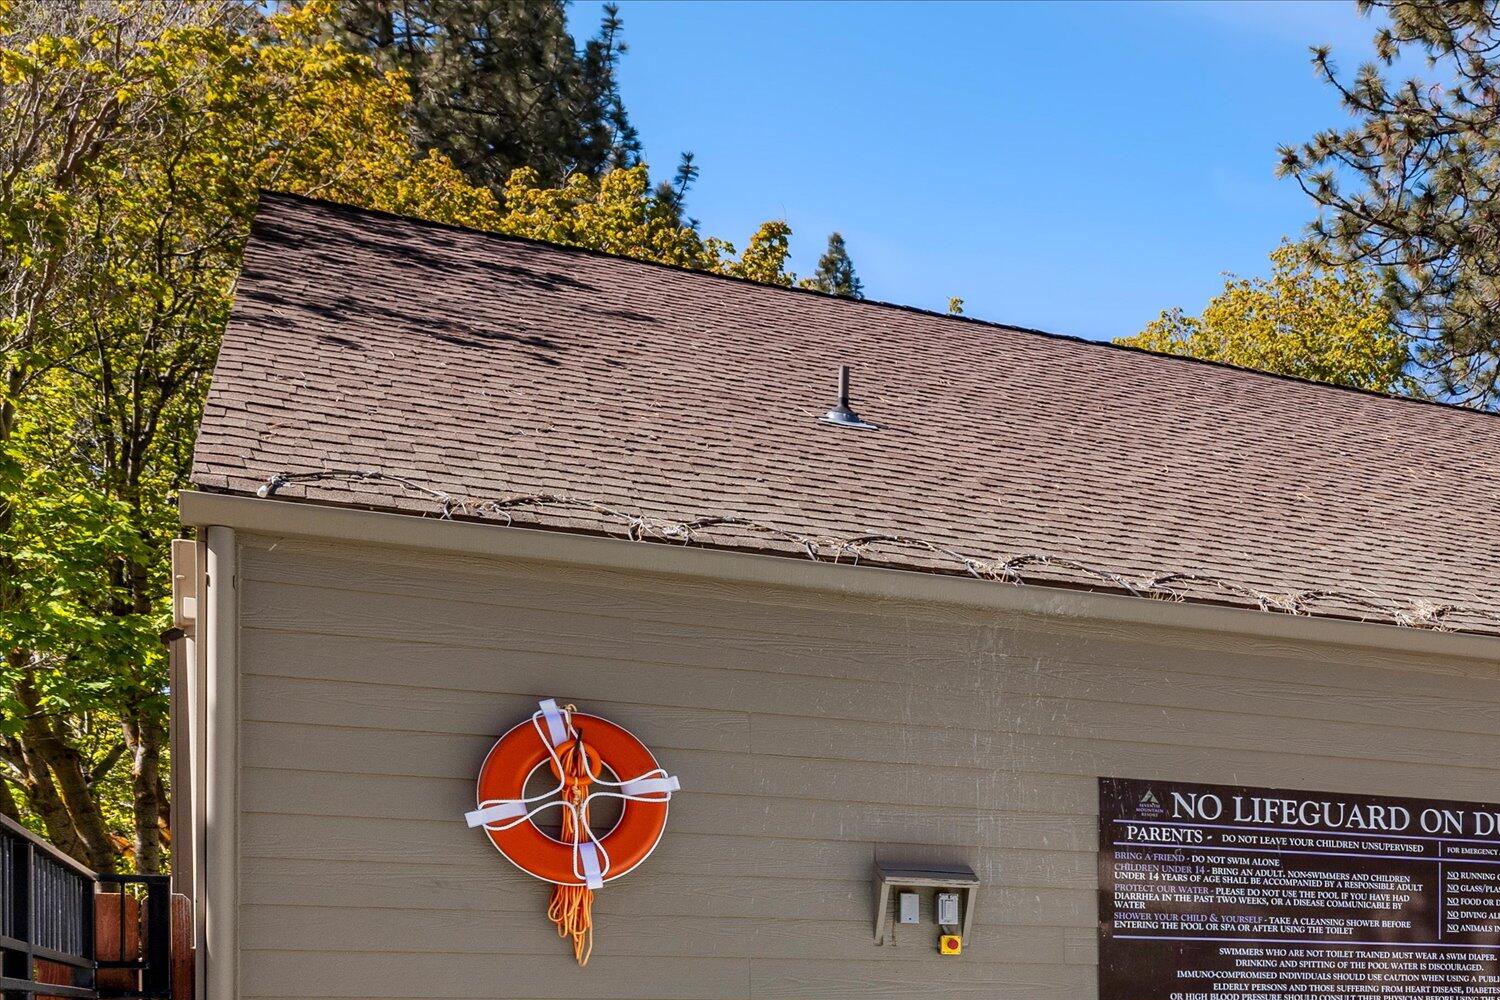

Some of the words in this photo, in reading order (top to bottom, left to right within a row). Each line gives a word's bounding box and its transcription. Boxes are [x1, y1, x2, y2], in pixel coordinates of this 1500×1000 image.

[1171, 792, 1222, 820] NO
[1233, 796, 1410, 831] LIFEGUARD
[1420, 808, 1464, 834] ON
[1128, 825, 1202, 843] PARENTS
[1222, 834, 1236, 843] DO
[1238, 835, 1257, 844] NOT
[1260, 836, 1287, 846] LEAVE
[1289, 838, 1314, 847] YOUR
[1316, 839, 1359, 849] CHILDREN
[1361, 842, 1423, 853] UNSUPERVISED
[1114, 852, 1142, 861] BRING
[1144, 853, 1150, 861] A
[1153, 853, 1184, 863] FRIEND
[1192, 855, 1204, 863] DO
[1207, 855, 1225, 864] NOT
[1227, 856, 1249, 865] SWIM
[1252, 857, 1279, 866] ALONE
[1461, 848, 1497, 856] EMERGENCY
[1114, 863, 1158, 873] CHILDREN
[1162, 865, 1191, 874] UNDER
[1195, 866, 1204, 874] 14
[1212, 867, 1238, 876] BRING
[1240, 868, 1252, 876] AN
[1254, 869, 1285, 877] ADULT.
[1287, 870, 1349, 880] NON-SWIMMERS
[1370, 873, 1410, 882] CHILDREN
[1460, 872, 1495, 880] RUNNING
[1114, 884, 1153, 893] PROTECT
[1156, 885, 1176, 894] OUR
[1178, 886, 1208, 895] WATER
[1215, 887, 1244, 896] PLEASE
[1247, 888, 1260, 896] DO
[1262, 889, 1280, 897] NOT
[1282, 890, 1297, 898] USE
[1299, 890, 1315, 898] THE
[1317, 891, 1338, 899] POOL
[1350, 892, 1366, 900] YOU
[1392, 893, 1409, 901] HAD
[1460, 898, 1481, 906] FOOD
[1482, 899, 1494, 907] OR
[1460, 911, 1486, 919] DIVING
[1114, 921, 1158, 930] ENTERING
[1162, 922, 1178, 931] THE
[1180, 923, 1203, 931] POOL
[1205, 924, 1218, 932] OR
[1220, 924, 1235, 932] SPA
[1252, 925, 1278, 933] AFTER
[1280, 926, 1305, 934] USING
[1326, 927, 1352, 935] TOILET
[1460, 924, 1492, 932] ANIMALS
[1219, 948, 1263, 956] SWIMMERS
[1288, 949, 1304, 957] ARE
[1355, 950, 1390, 958] TRAINED
[1468, 952, 1496, 960] DIAPER.
